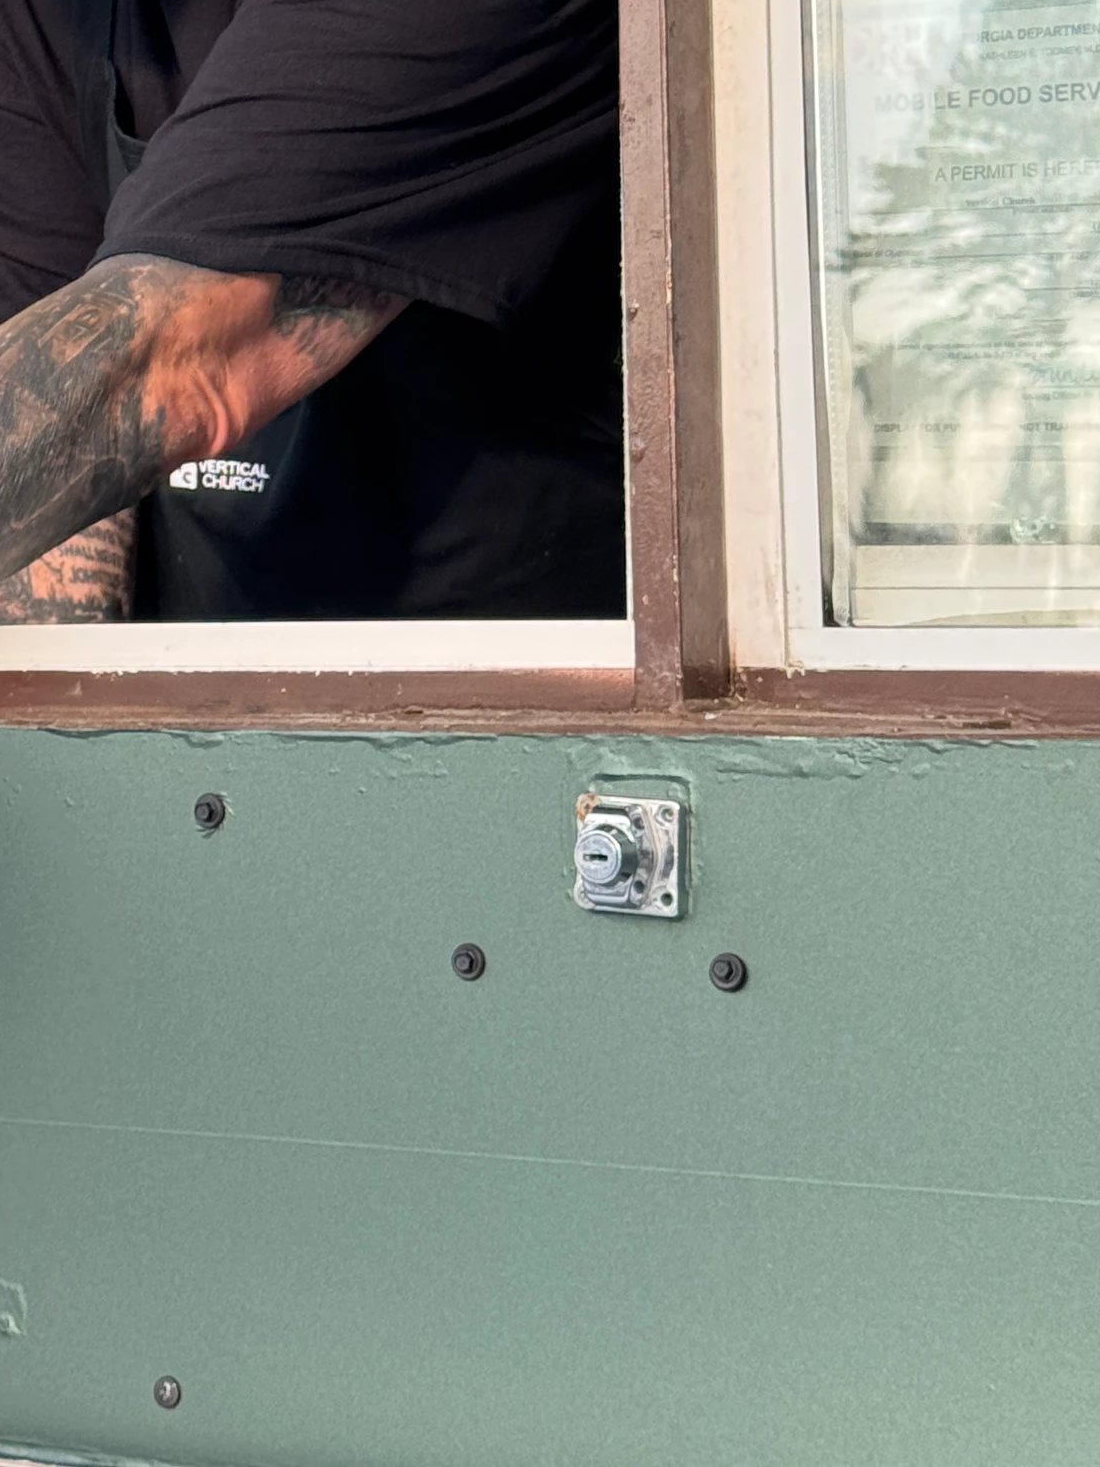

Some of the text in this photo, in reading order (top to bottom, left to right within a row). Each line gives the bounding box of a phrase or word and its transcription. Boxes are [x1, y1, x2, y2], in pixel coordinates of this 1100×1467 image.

[968, 86, 1032, 108] FOOD
[1038, 82, 1100, 103] SERV
[934, 167, 948, 182] A
[950, 163, 1017, 181] PERMIT
[1022, 162, 1039, 178] IS
[198, 459, 271, 480] VERTICAL
[201, 474, 266, 494] CHURCH
